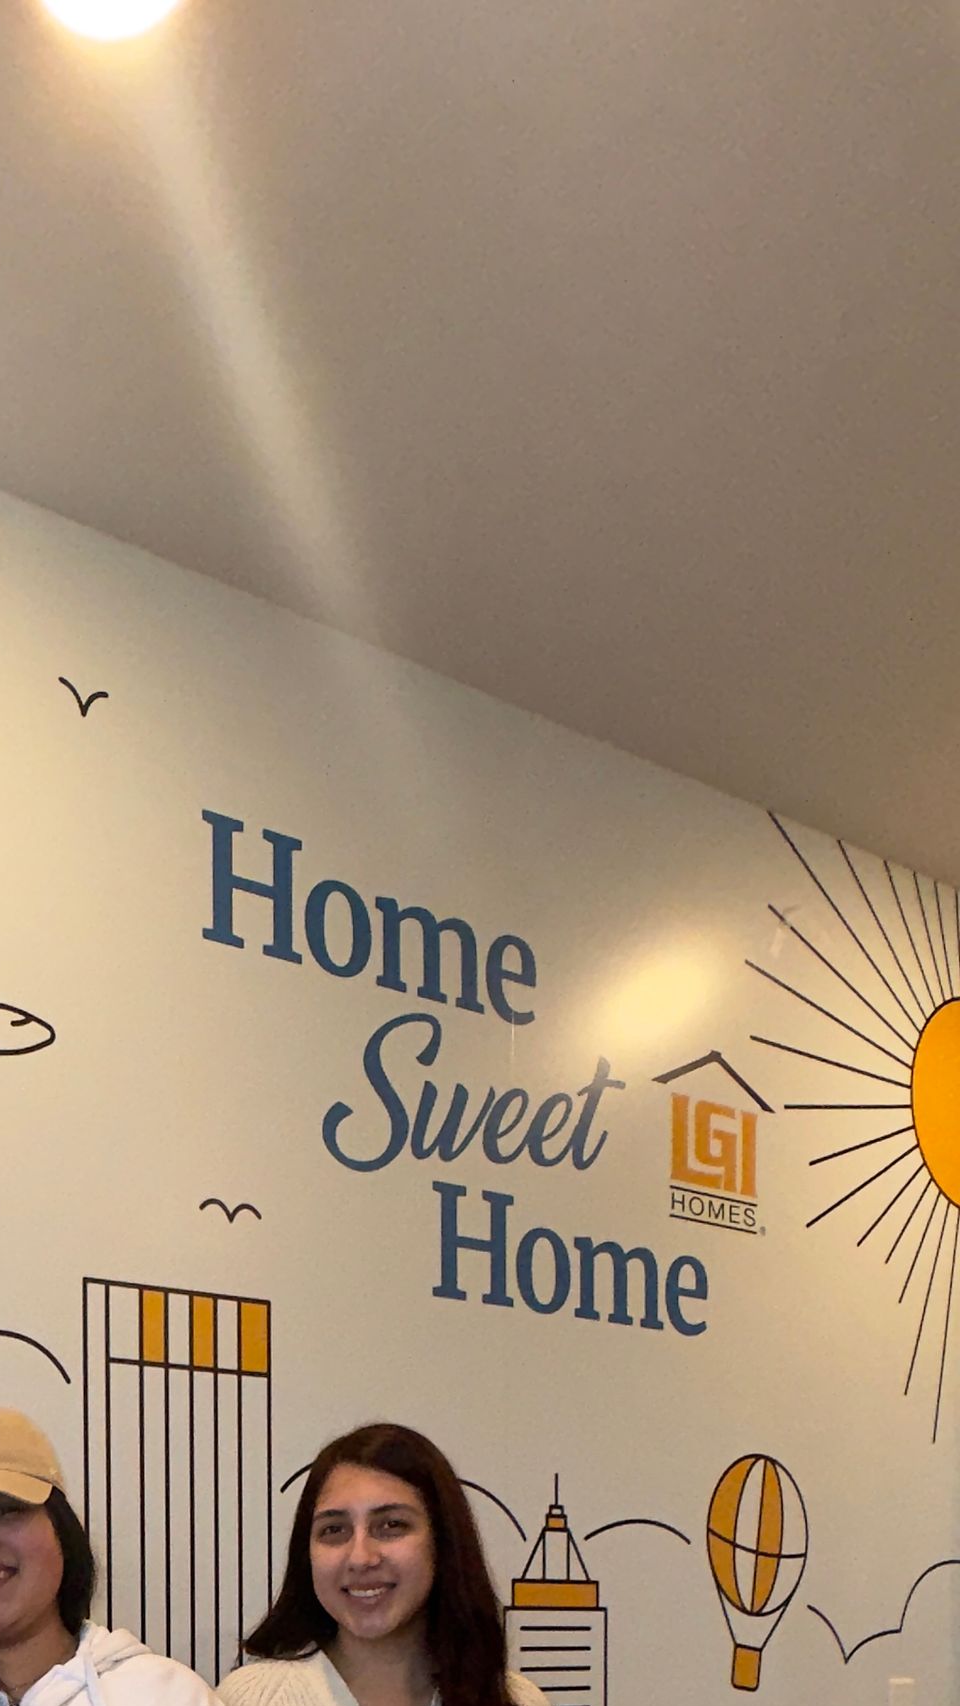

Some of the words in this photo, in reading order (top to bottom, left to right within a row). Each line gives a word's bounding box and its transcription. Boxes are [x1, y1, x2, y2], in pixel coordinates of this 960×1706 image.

[202, 809, 537, 1026] Home
[322, 1012, 626, 1173] Sweet
[671, 1092, 758, 1198] LGI
[432, 1181, 708, 1336] Home
[671, 1191, 757, 1227] HOMES
